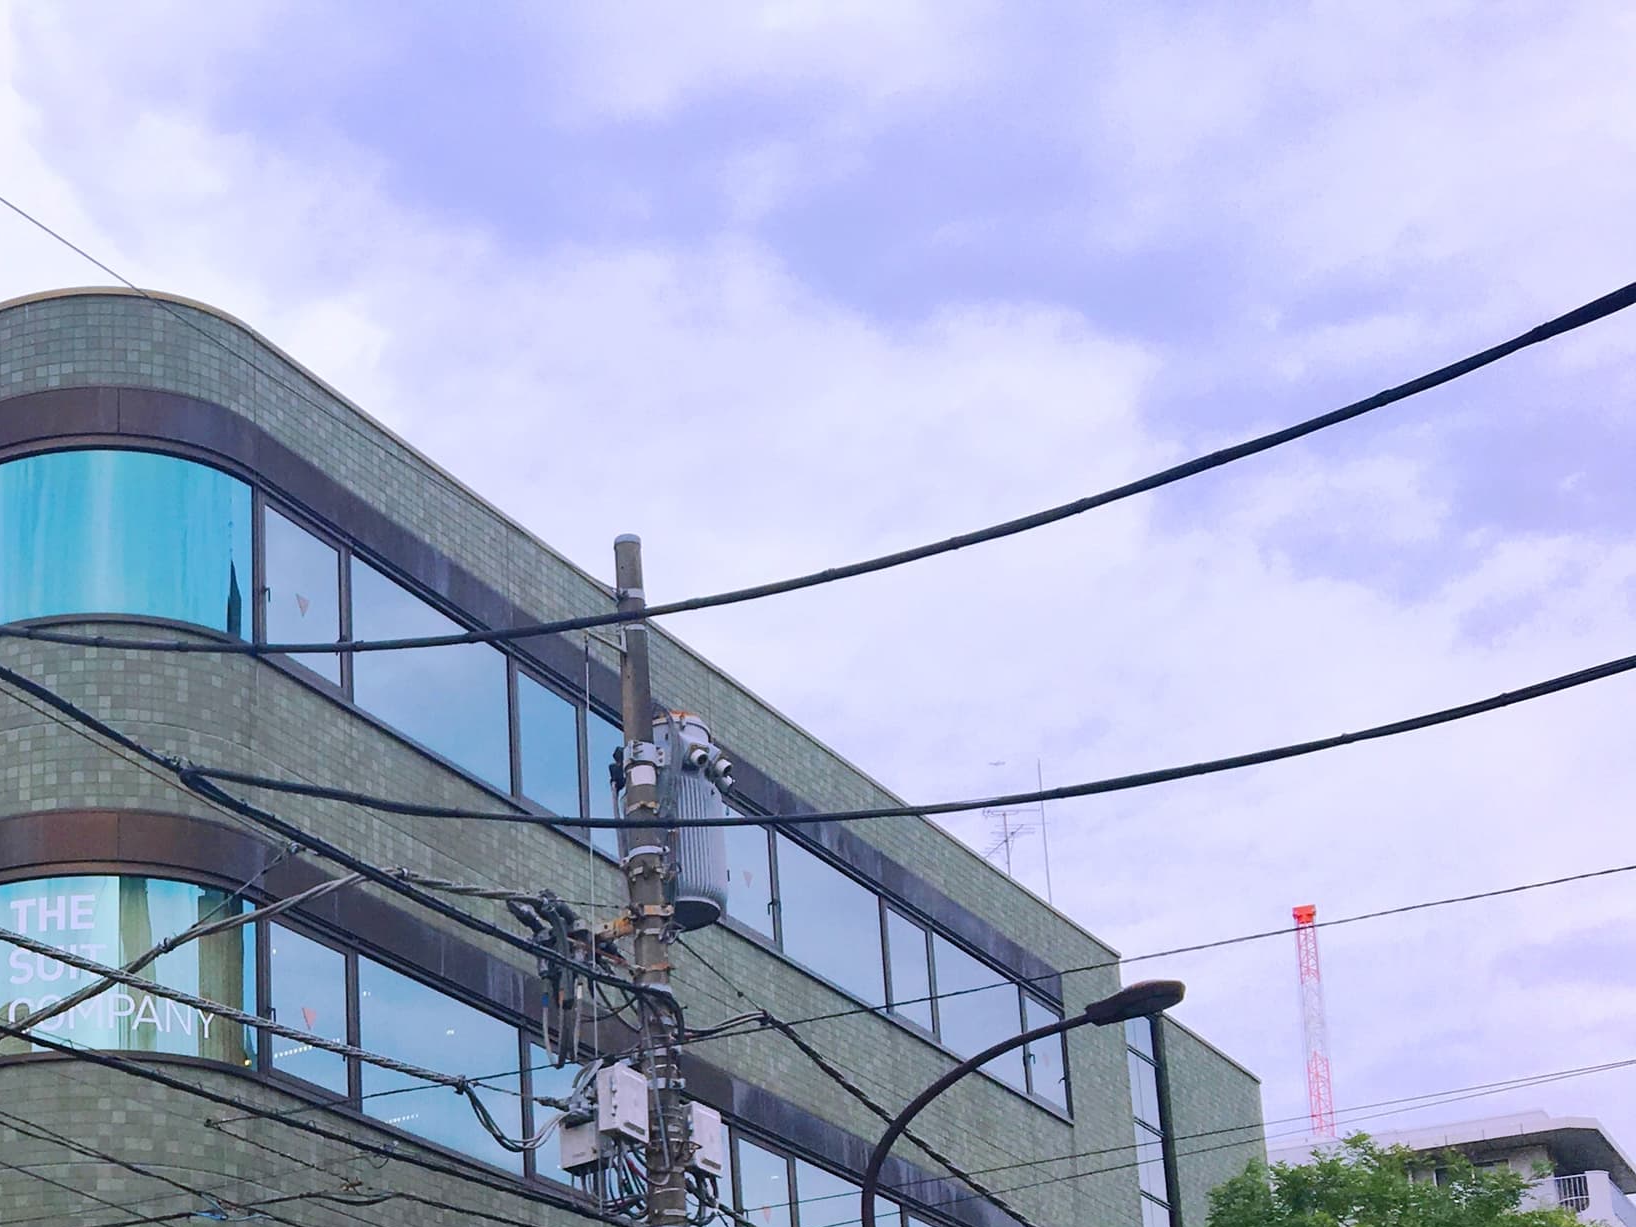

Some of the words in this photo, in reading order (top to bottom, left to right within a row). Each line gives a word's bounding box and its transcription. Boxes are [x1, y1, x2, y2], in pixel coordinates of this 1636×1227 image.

[9, 893, 97, 935] THE
[8, 943, 108, 985] SUIT
[8, 993, 215, 1040] COMPANY
